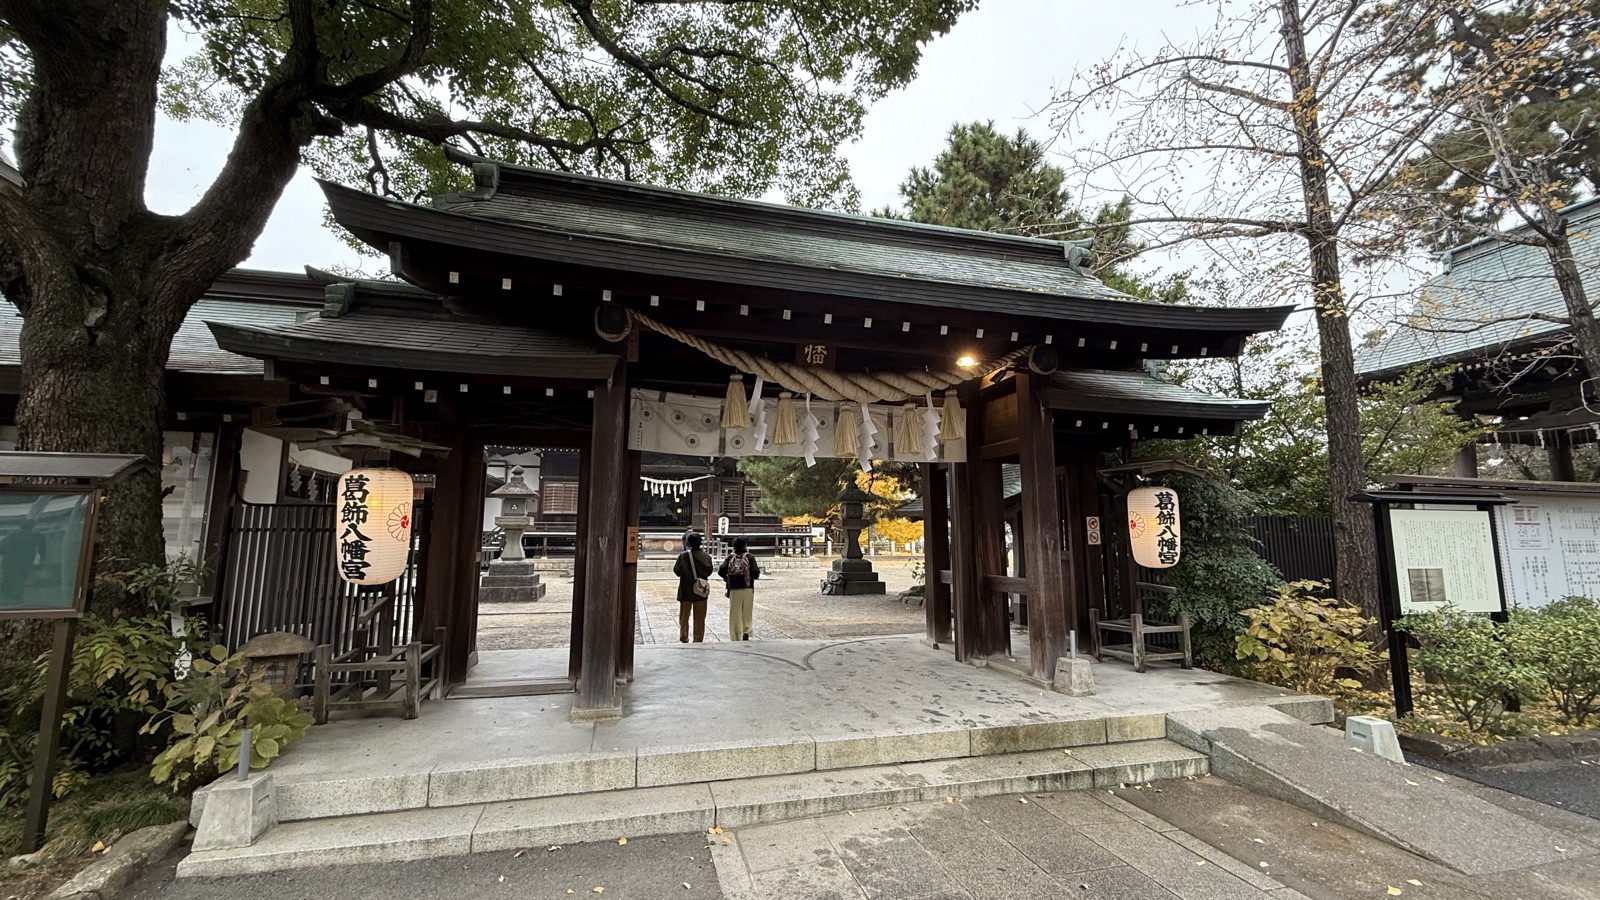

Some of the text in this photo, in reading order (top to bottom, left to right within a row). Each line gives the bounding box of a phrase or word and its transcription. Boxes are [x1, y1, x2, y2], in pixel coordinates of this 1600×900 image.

[340, 474, 373, 580] 葛飾八幡宮
[1154, 491, 1178, 565] 葛飾八幡宮
